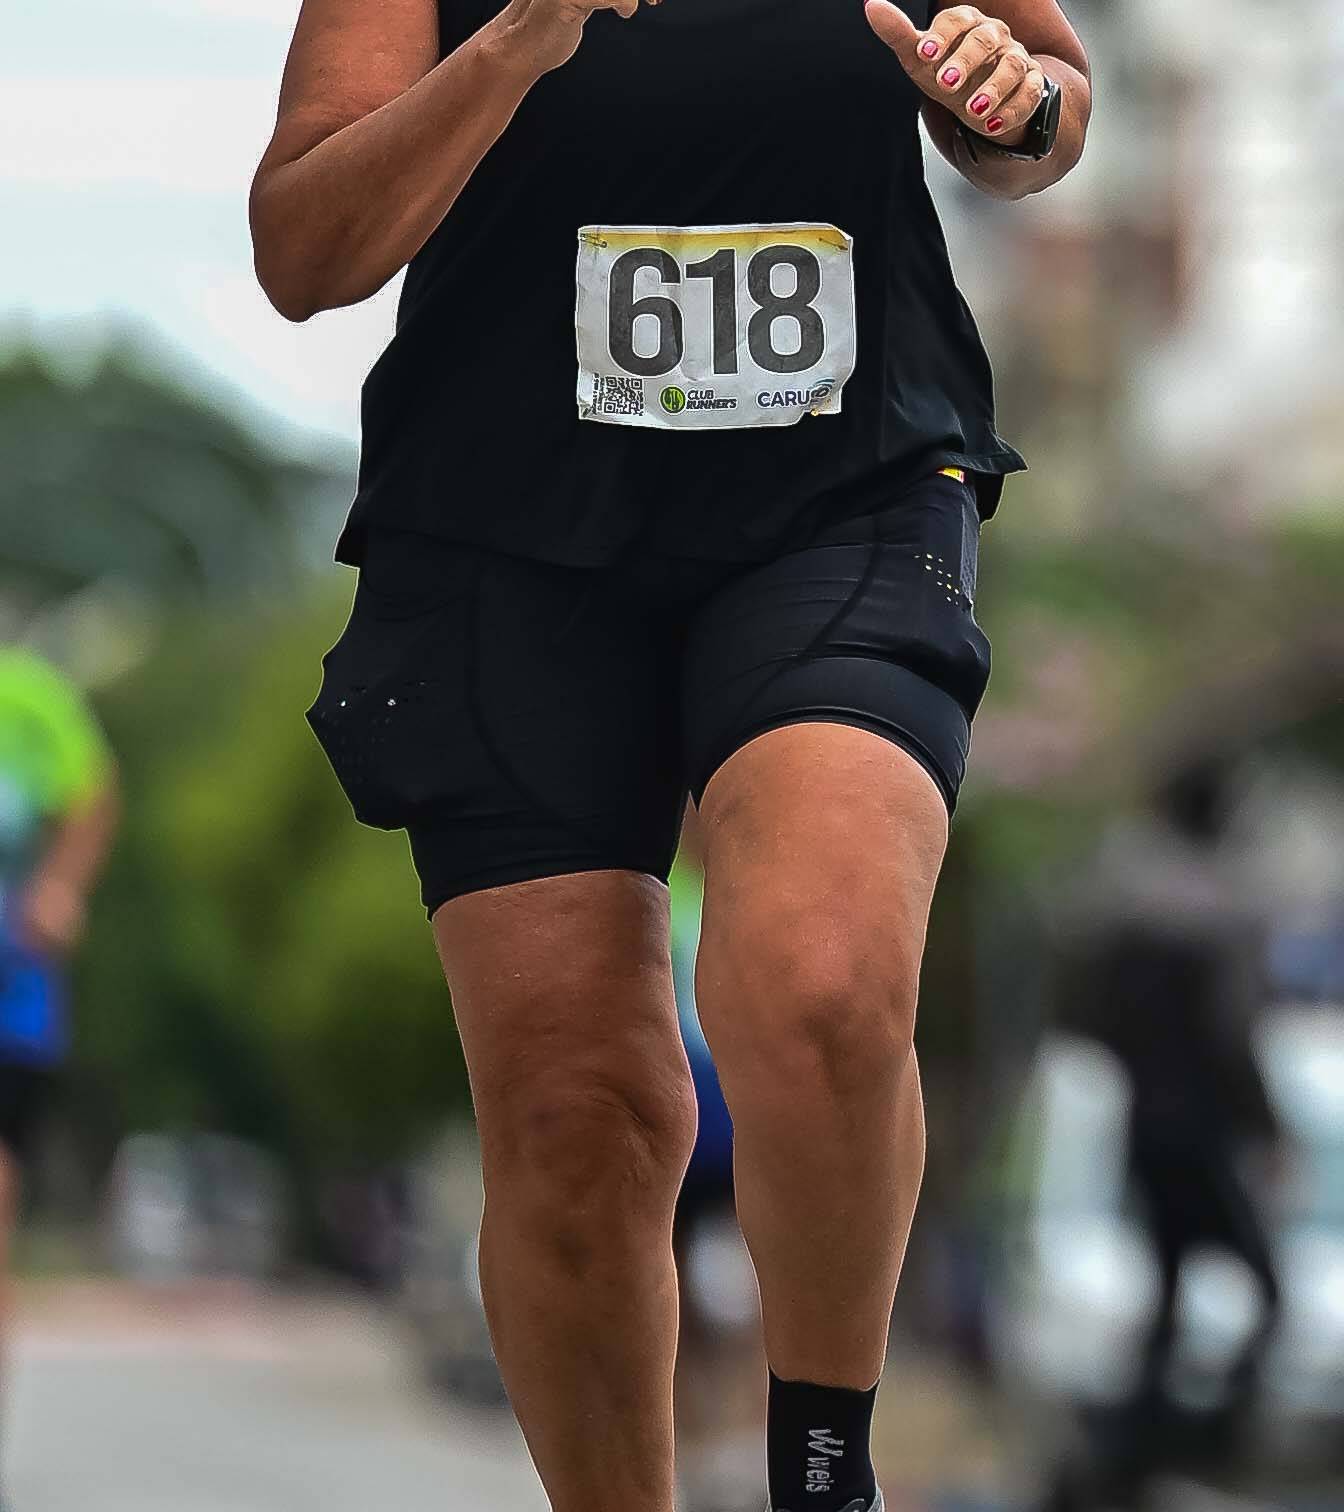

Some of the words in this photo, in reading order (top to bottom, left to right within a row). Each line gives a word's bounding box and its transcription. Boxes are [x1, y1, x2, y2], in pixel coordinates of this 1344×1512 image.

[608, 243, 825, 378] 618
[687, 388, 714, 400] CLUB
[685, 397, 738, 411] RUNNER'S
